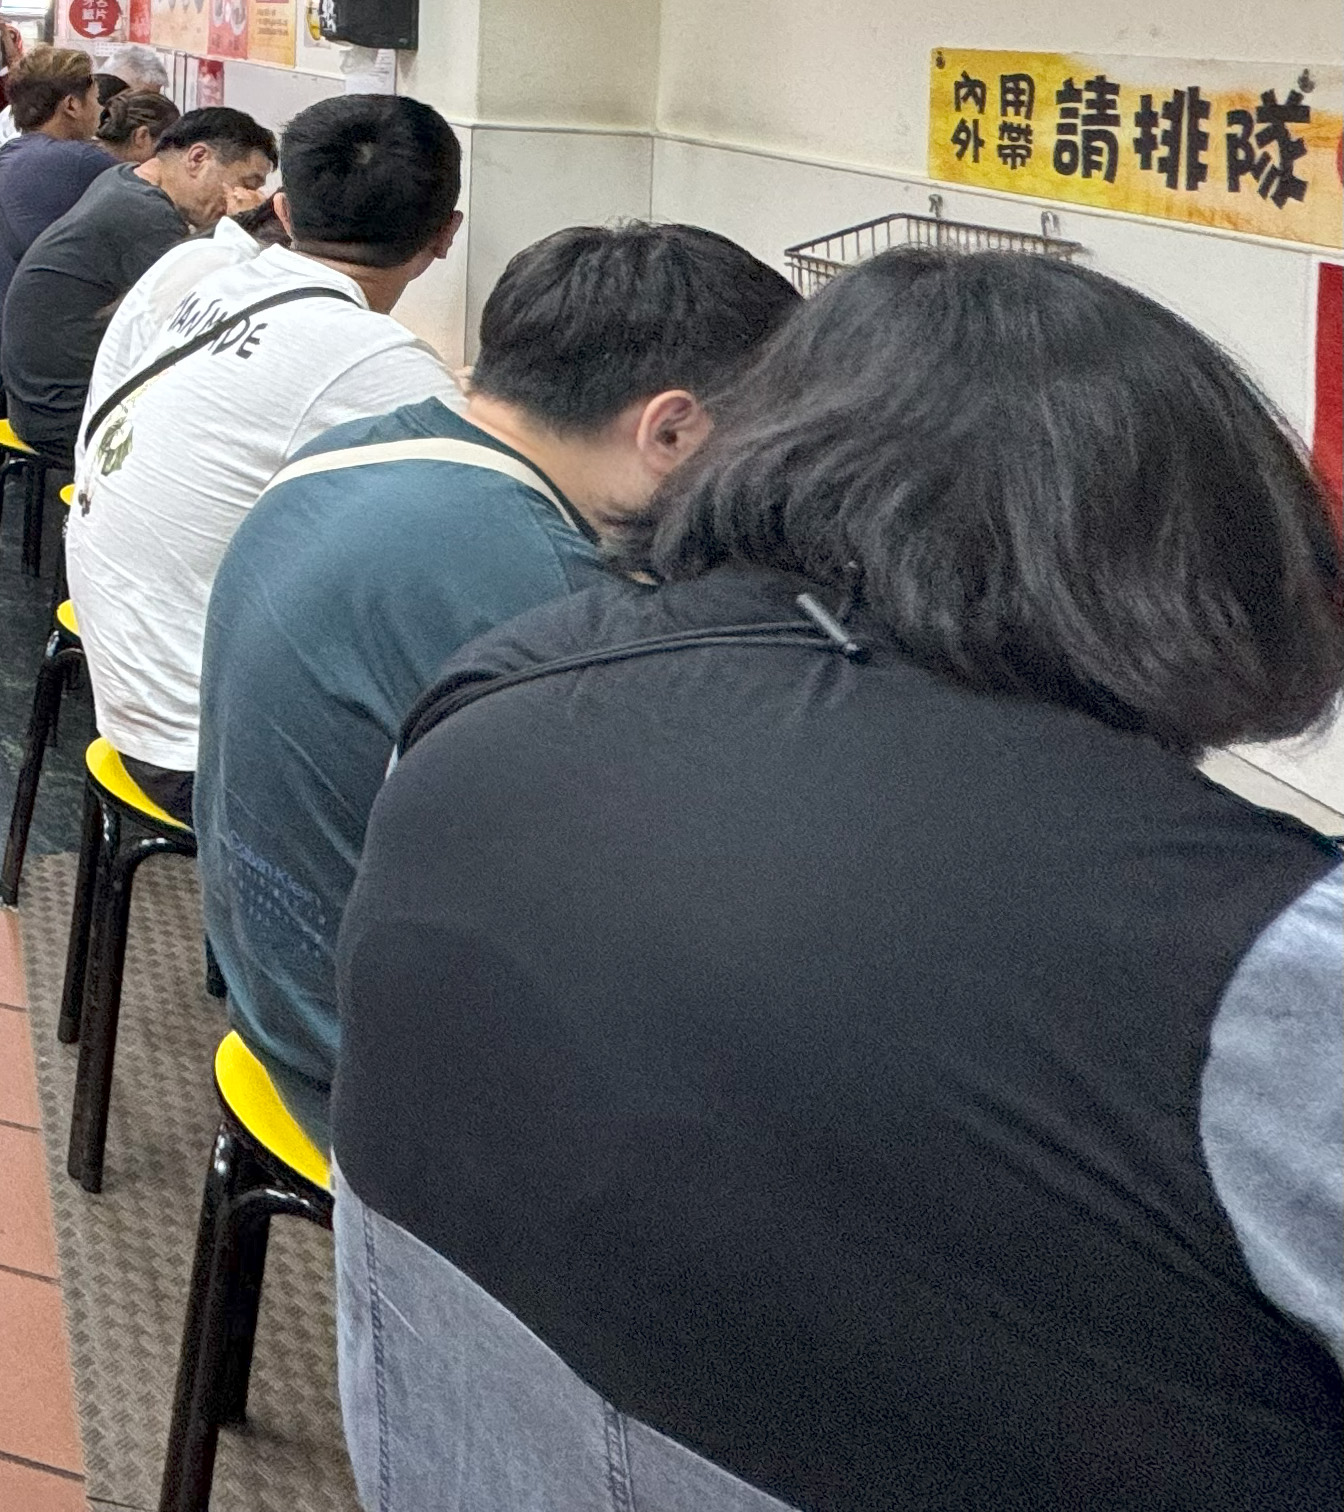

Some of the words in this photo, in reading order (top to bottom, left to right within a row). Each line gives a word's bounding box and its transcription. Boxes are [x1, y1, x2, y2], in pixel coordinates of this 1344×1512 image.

[950, 117, 1034, 170] 外帶
[953, 70, 1036, 121] 內用
[1052, 74, 1312, 210] 請排隊
